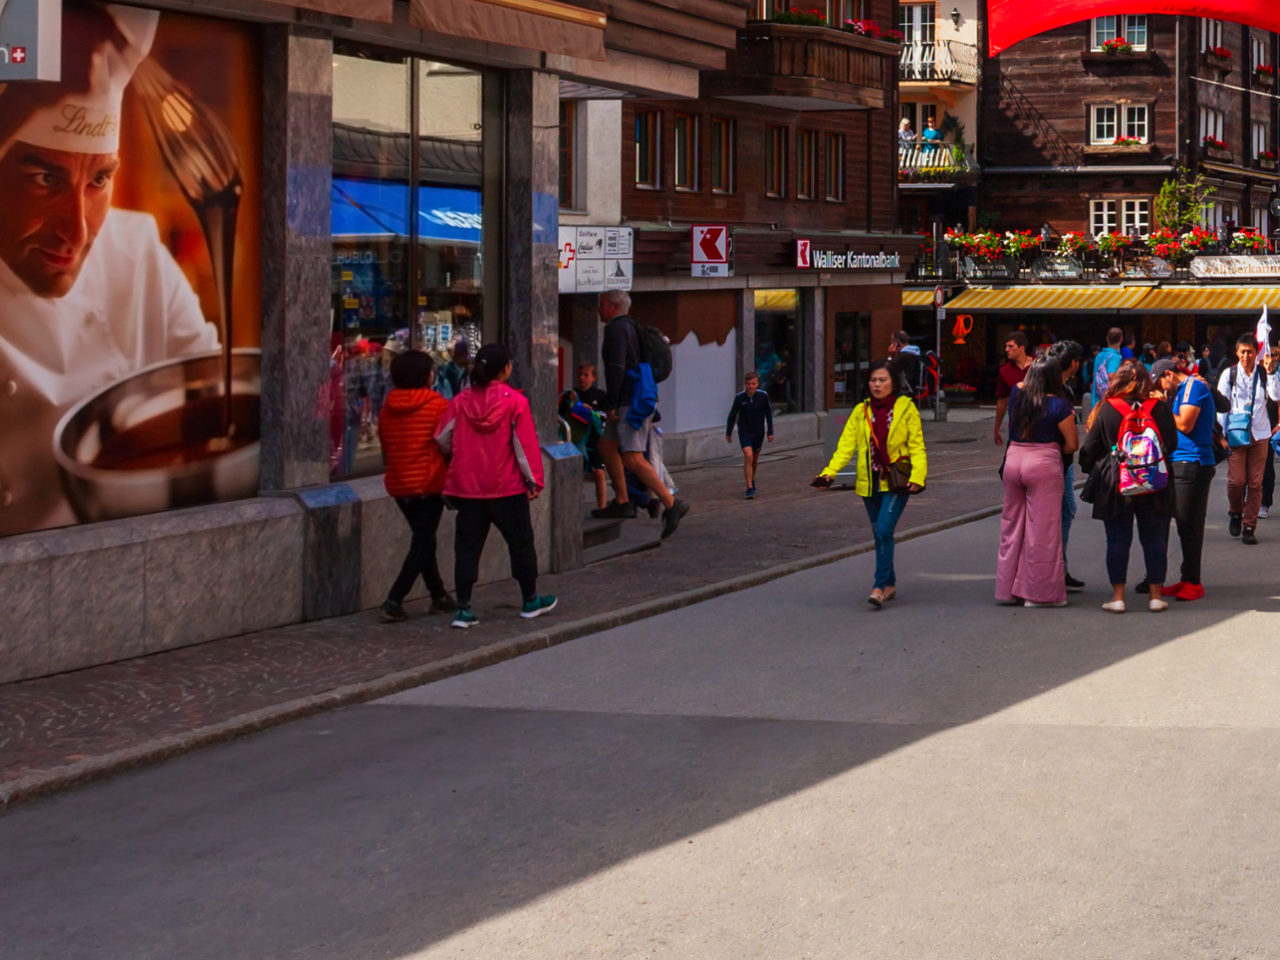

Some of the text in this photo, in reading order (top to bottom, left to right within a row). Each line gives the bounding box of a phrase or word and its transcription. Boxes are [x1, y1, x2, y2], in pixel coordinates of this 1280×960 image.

[53, 104, 113, 137] Lindt
[813, 250, 900, 268] Walliser Kantonalbank
